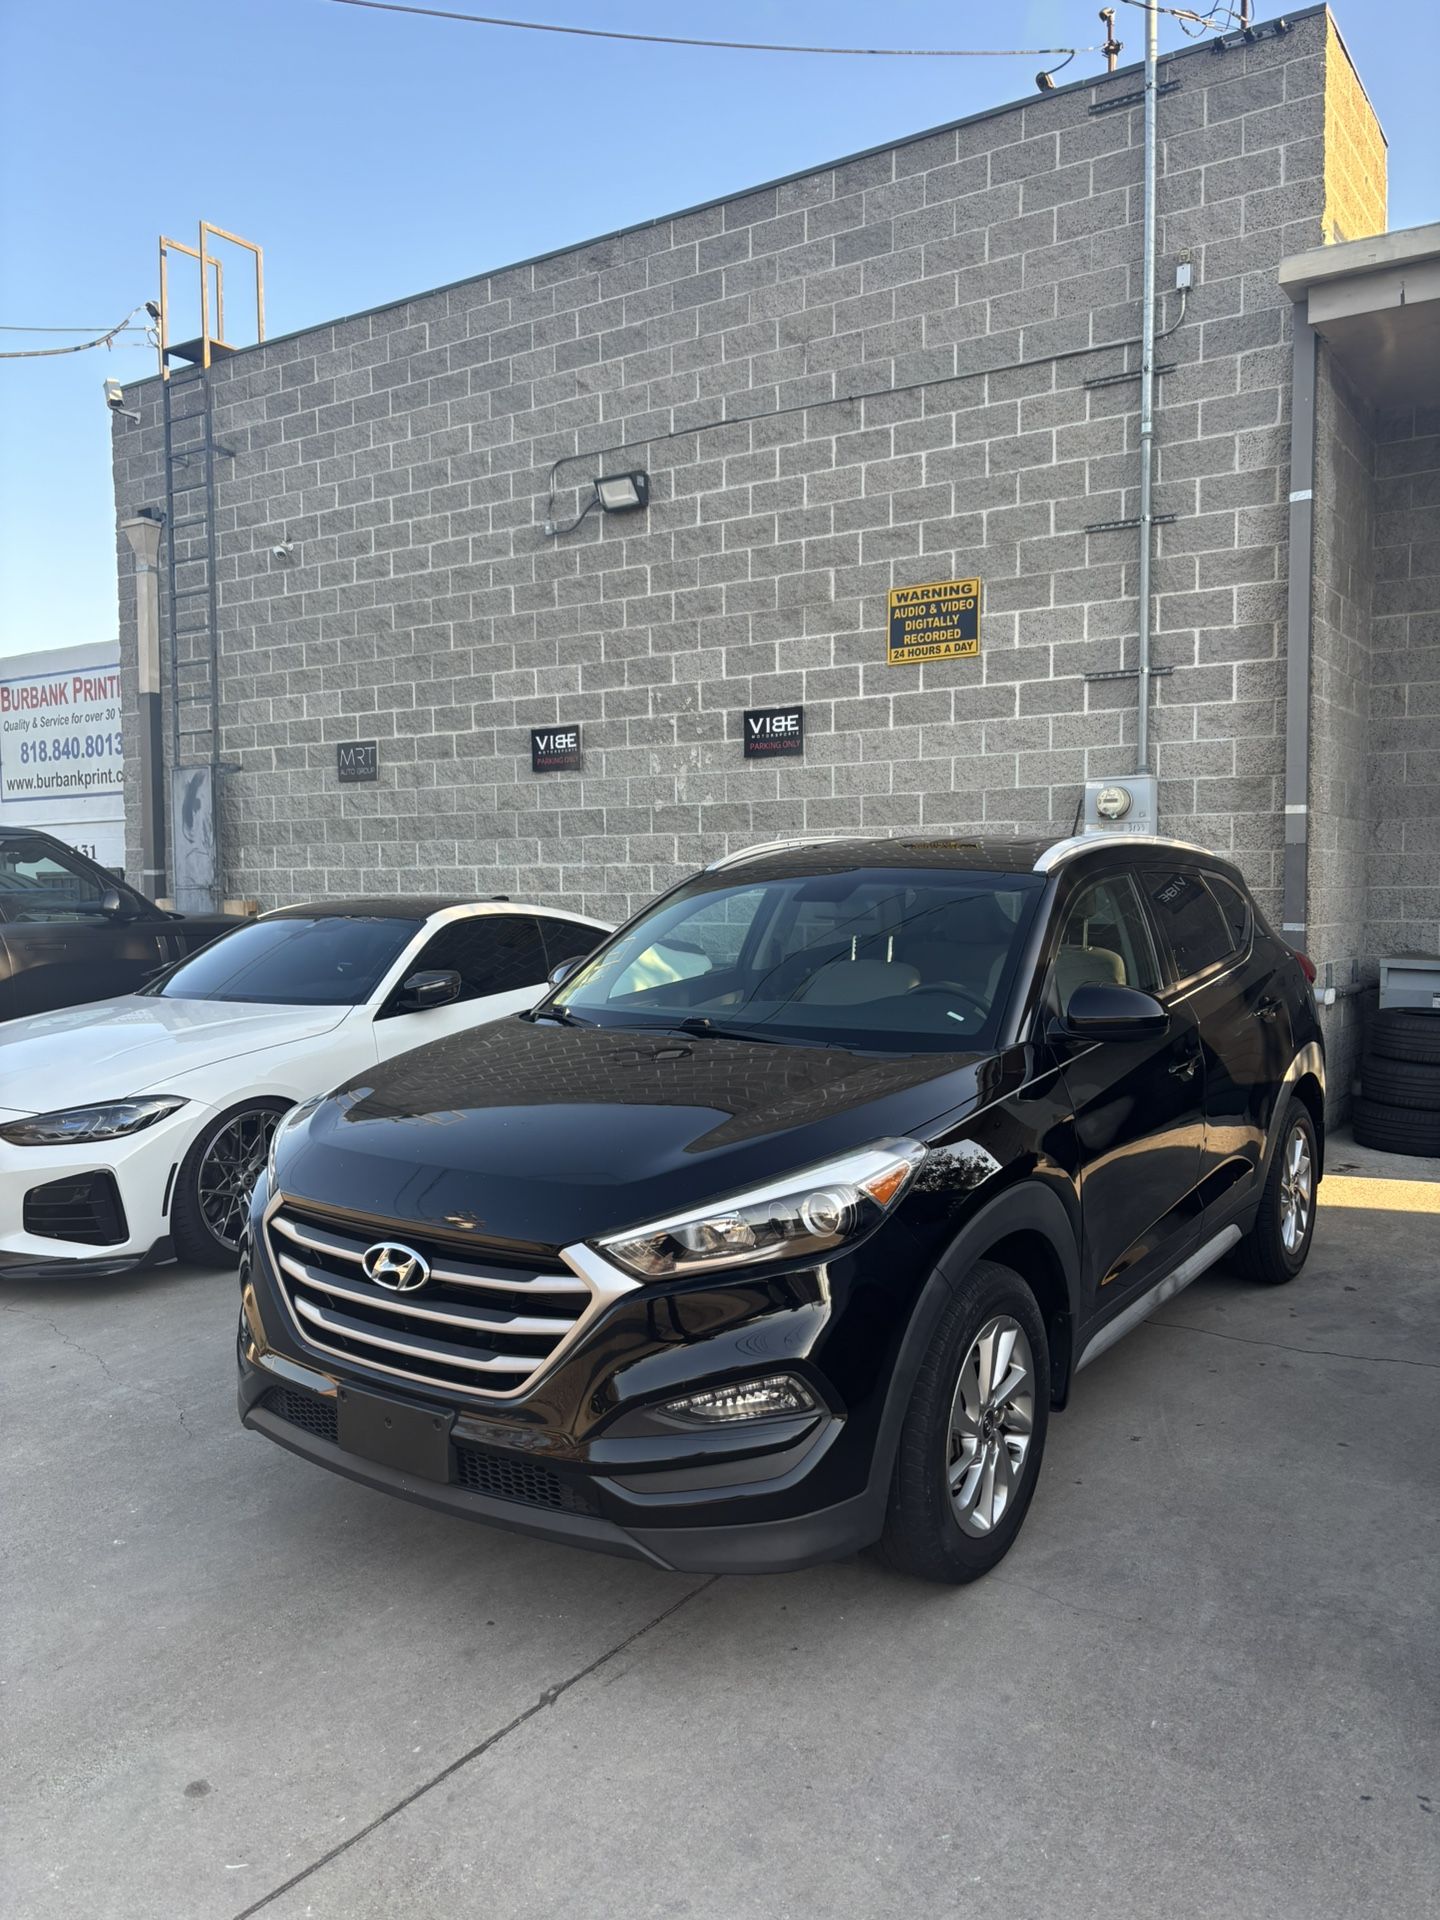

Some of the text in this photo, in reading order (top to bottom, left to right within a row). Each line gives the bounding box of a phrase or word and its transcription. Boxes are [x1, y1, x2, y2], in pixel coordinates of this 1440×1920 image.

[896, 584, 972, 603] WARNING
[893, 599, 974, 619] AUDIO & VIDEO
[905, 614, 960, 631] DIGITALLY
[904, 629, 961, 645] RECORDED
[893, 641, 974, 659] 24 HOURS A DAY
[0, 682, 69, 712] BURBANK
[3, 718, 30, 732] Quality
[32, 717, 38, 728] &
[40, 715, 69, 728] Service
[71, 712, 83, 724] for
[84, 712, 103, 723] over
[105, 708, 116, 720] 30
[748, 714, 799, 734] VIBE
[20, 732, 123, 764] 818.840.8013
[535, 732, 577, 750] VIBE
[750, 741, 781, 750] PARKING
[340, 746, 376, 767] MRT
